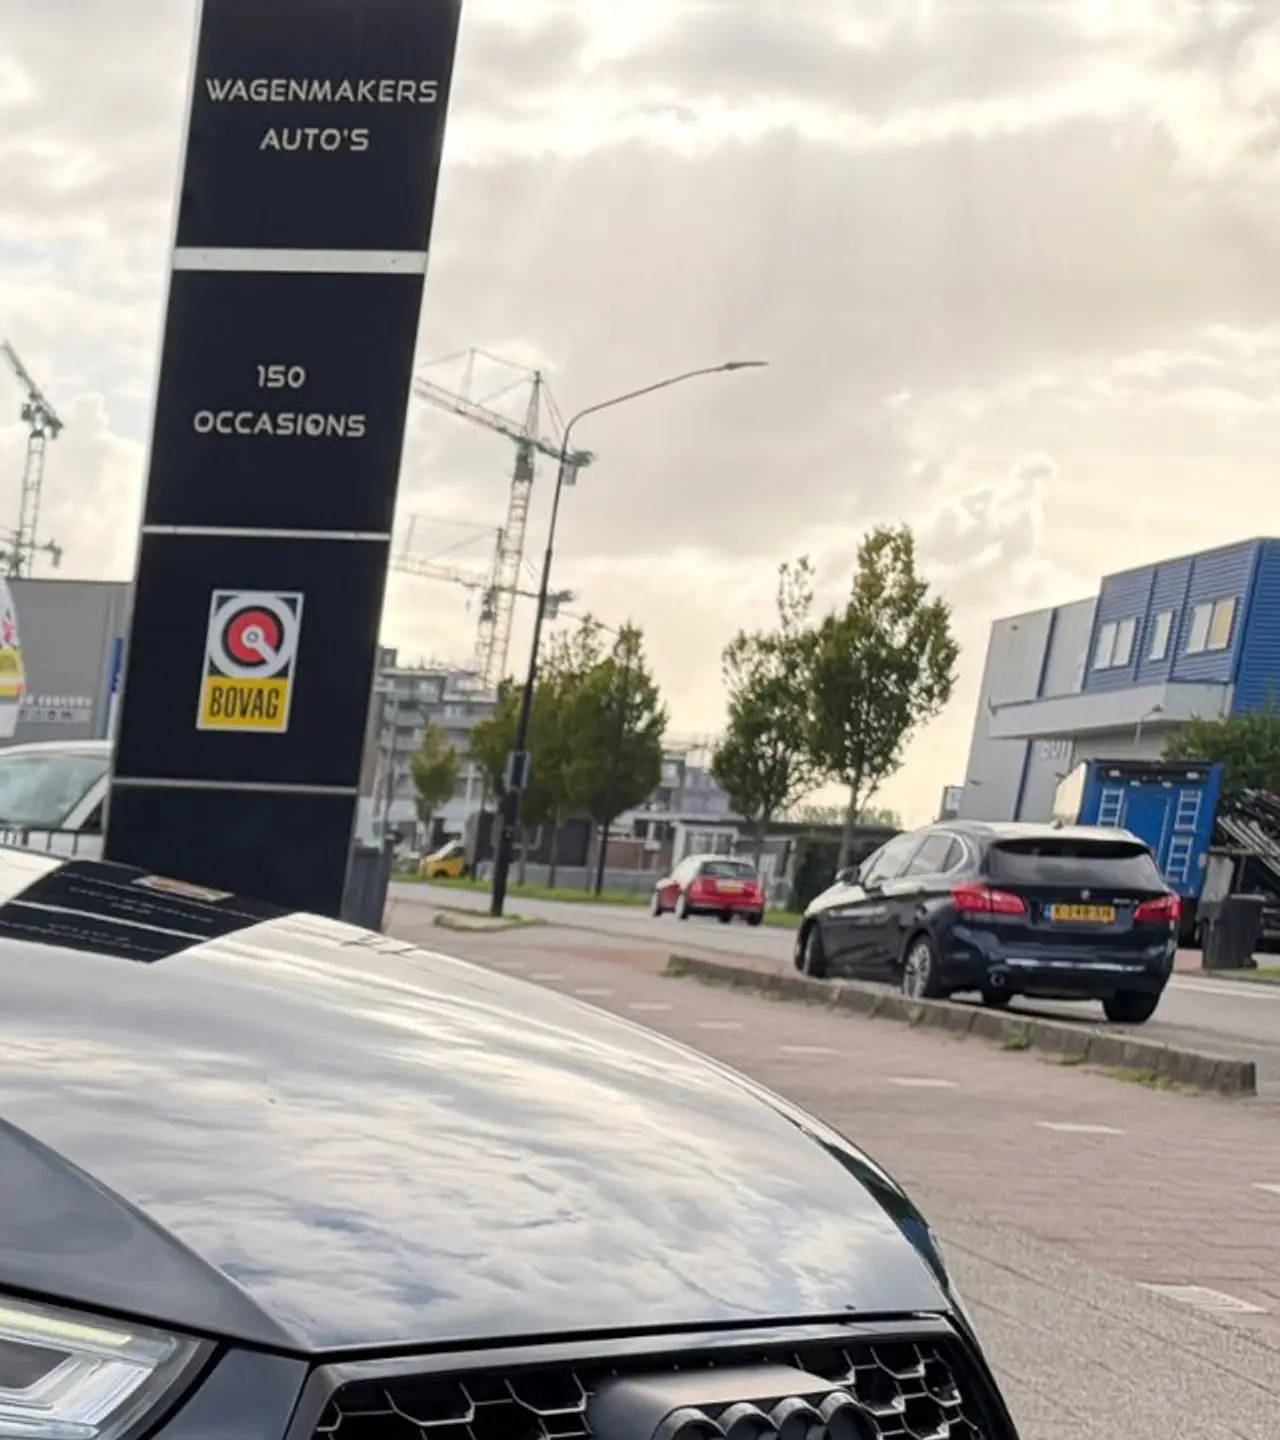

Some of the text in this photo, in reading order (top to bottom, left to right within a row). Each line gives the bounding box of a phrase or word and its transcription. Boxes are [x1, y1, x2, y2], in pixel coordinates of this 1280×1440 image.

[205, 78, 439, 103] WAGENMAKERS
[259, 127, 371, 152] AUTO'S
[256, 364, 306, 389] 150
[193, 409, 367, 438] OCCASIONS
[209, 685, 281, 720] BOVAG
